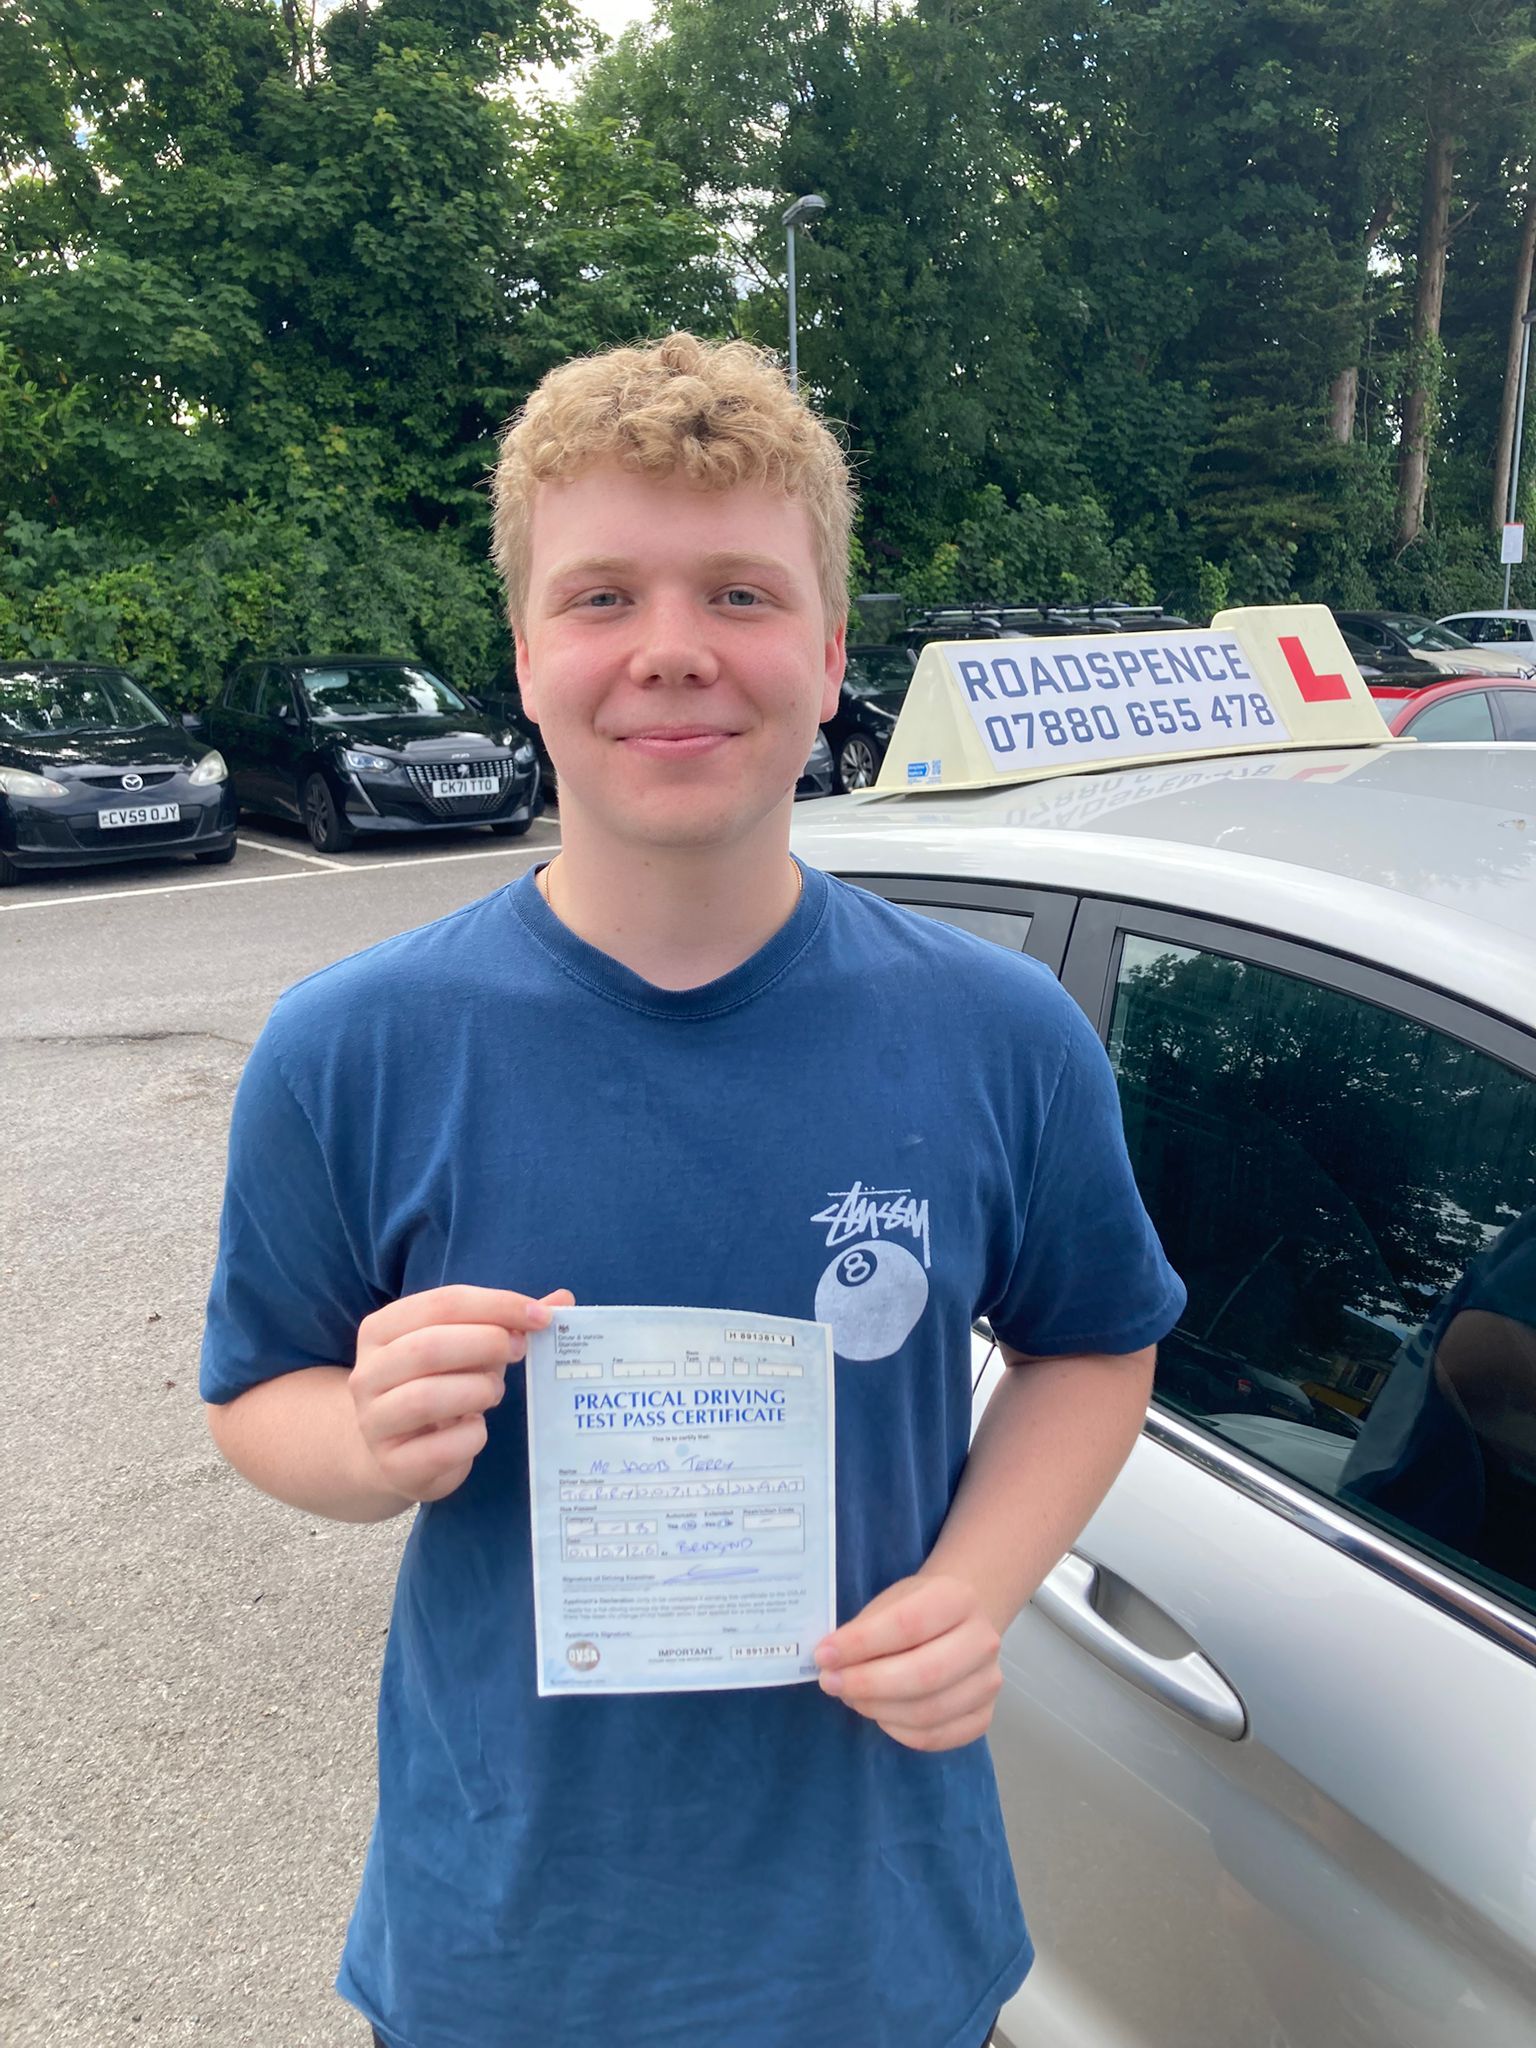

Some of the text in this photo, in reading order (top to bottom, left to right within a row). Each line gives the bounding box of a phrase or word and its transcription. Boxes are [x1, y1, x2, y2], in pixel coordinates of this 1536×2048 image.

[958, 643, 1251, 702] ROADSPENCE
[1277, 636, 1352, 703] L
[985, 693, 1275, 753] 07880 655 478
[440, 779, 492, 794] CK71 TTO
[109, 806, 177, 825] CV59 OJY
[729, 1332, 736, 1340] H
[574, 1389, 785, 1410] PRACTICAL DRIVING
[575, 1407, 786, 1429] TEST PASS CERTIFICATE
[658, 1647, 713, 1657] IMPORTANT
[735, 1648, 742, 1656] H
[784, 1646, 791, 1654] V
